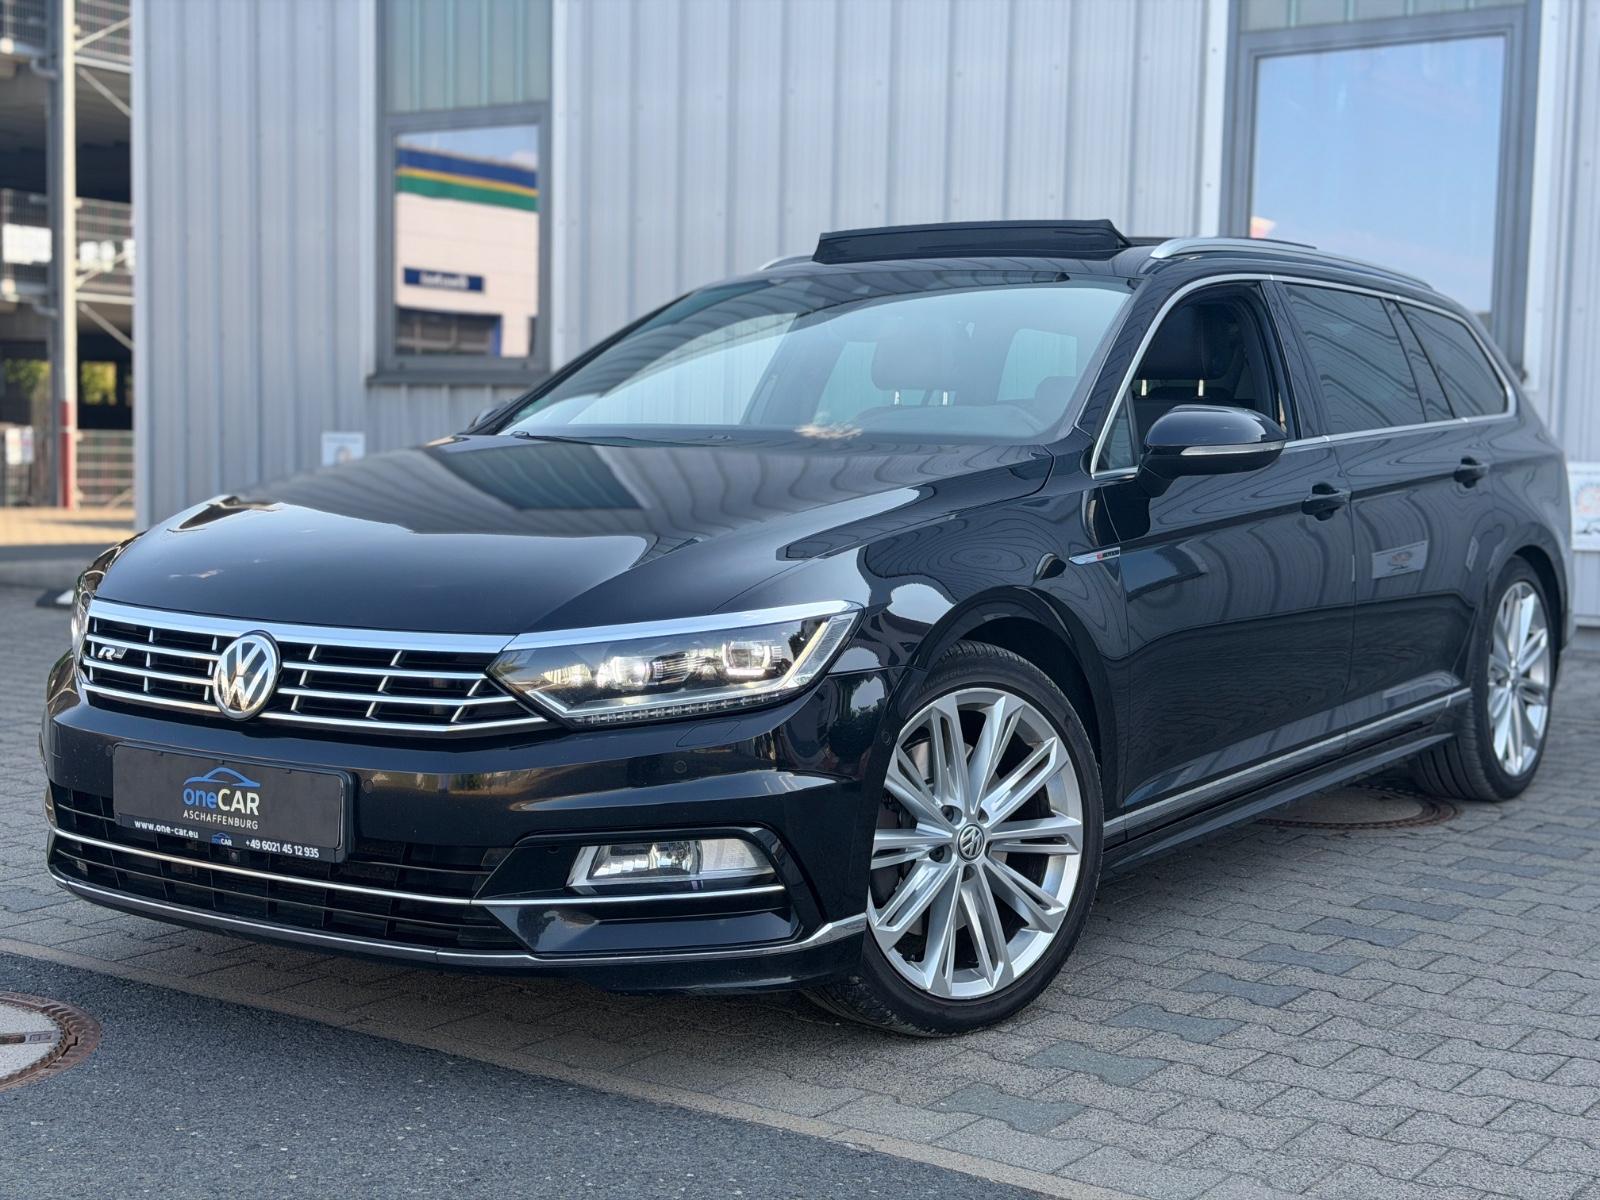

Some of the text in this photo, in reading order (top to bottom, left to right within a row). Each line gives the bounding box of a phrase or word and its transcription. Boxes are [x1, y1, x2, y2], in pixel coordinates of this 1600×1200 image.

[183, 788, 260, 816] oneCAR
[134, 820, 199, 839] www.one-car.eu
[182, 809, 259, 830] ASCHAFFENBURG
[245, 839, 320, 859] +49 6021 45 12 935
